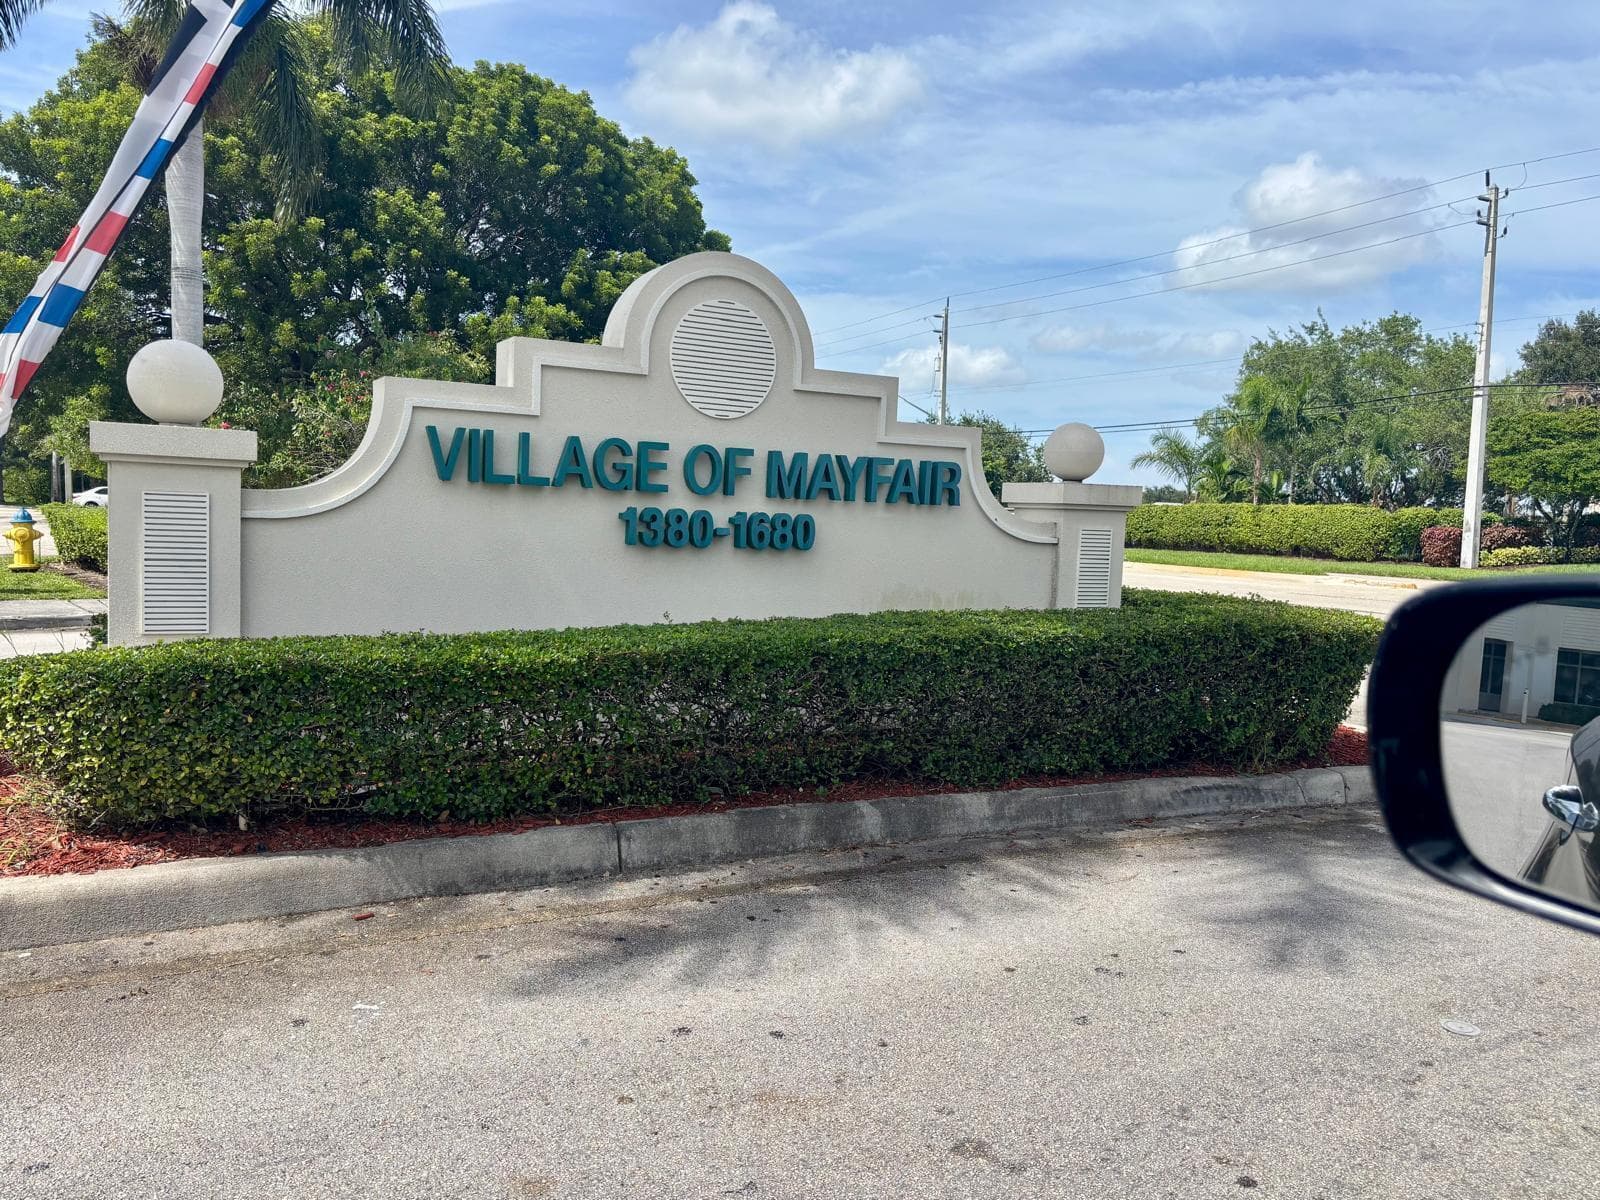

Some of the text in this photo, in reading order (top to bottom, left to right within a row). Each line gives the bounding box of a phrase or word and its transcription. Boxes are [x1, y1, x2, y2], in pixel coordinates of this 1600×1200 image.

[425, 425, 961, 506] VILLAGE OF MAYFAIR
[619, 507, 815, 551] 1380-1680
